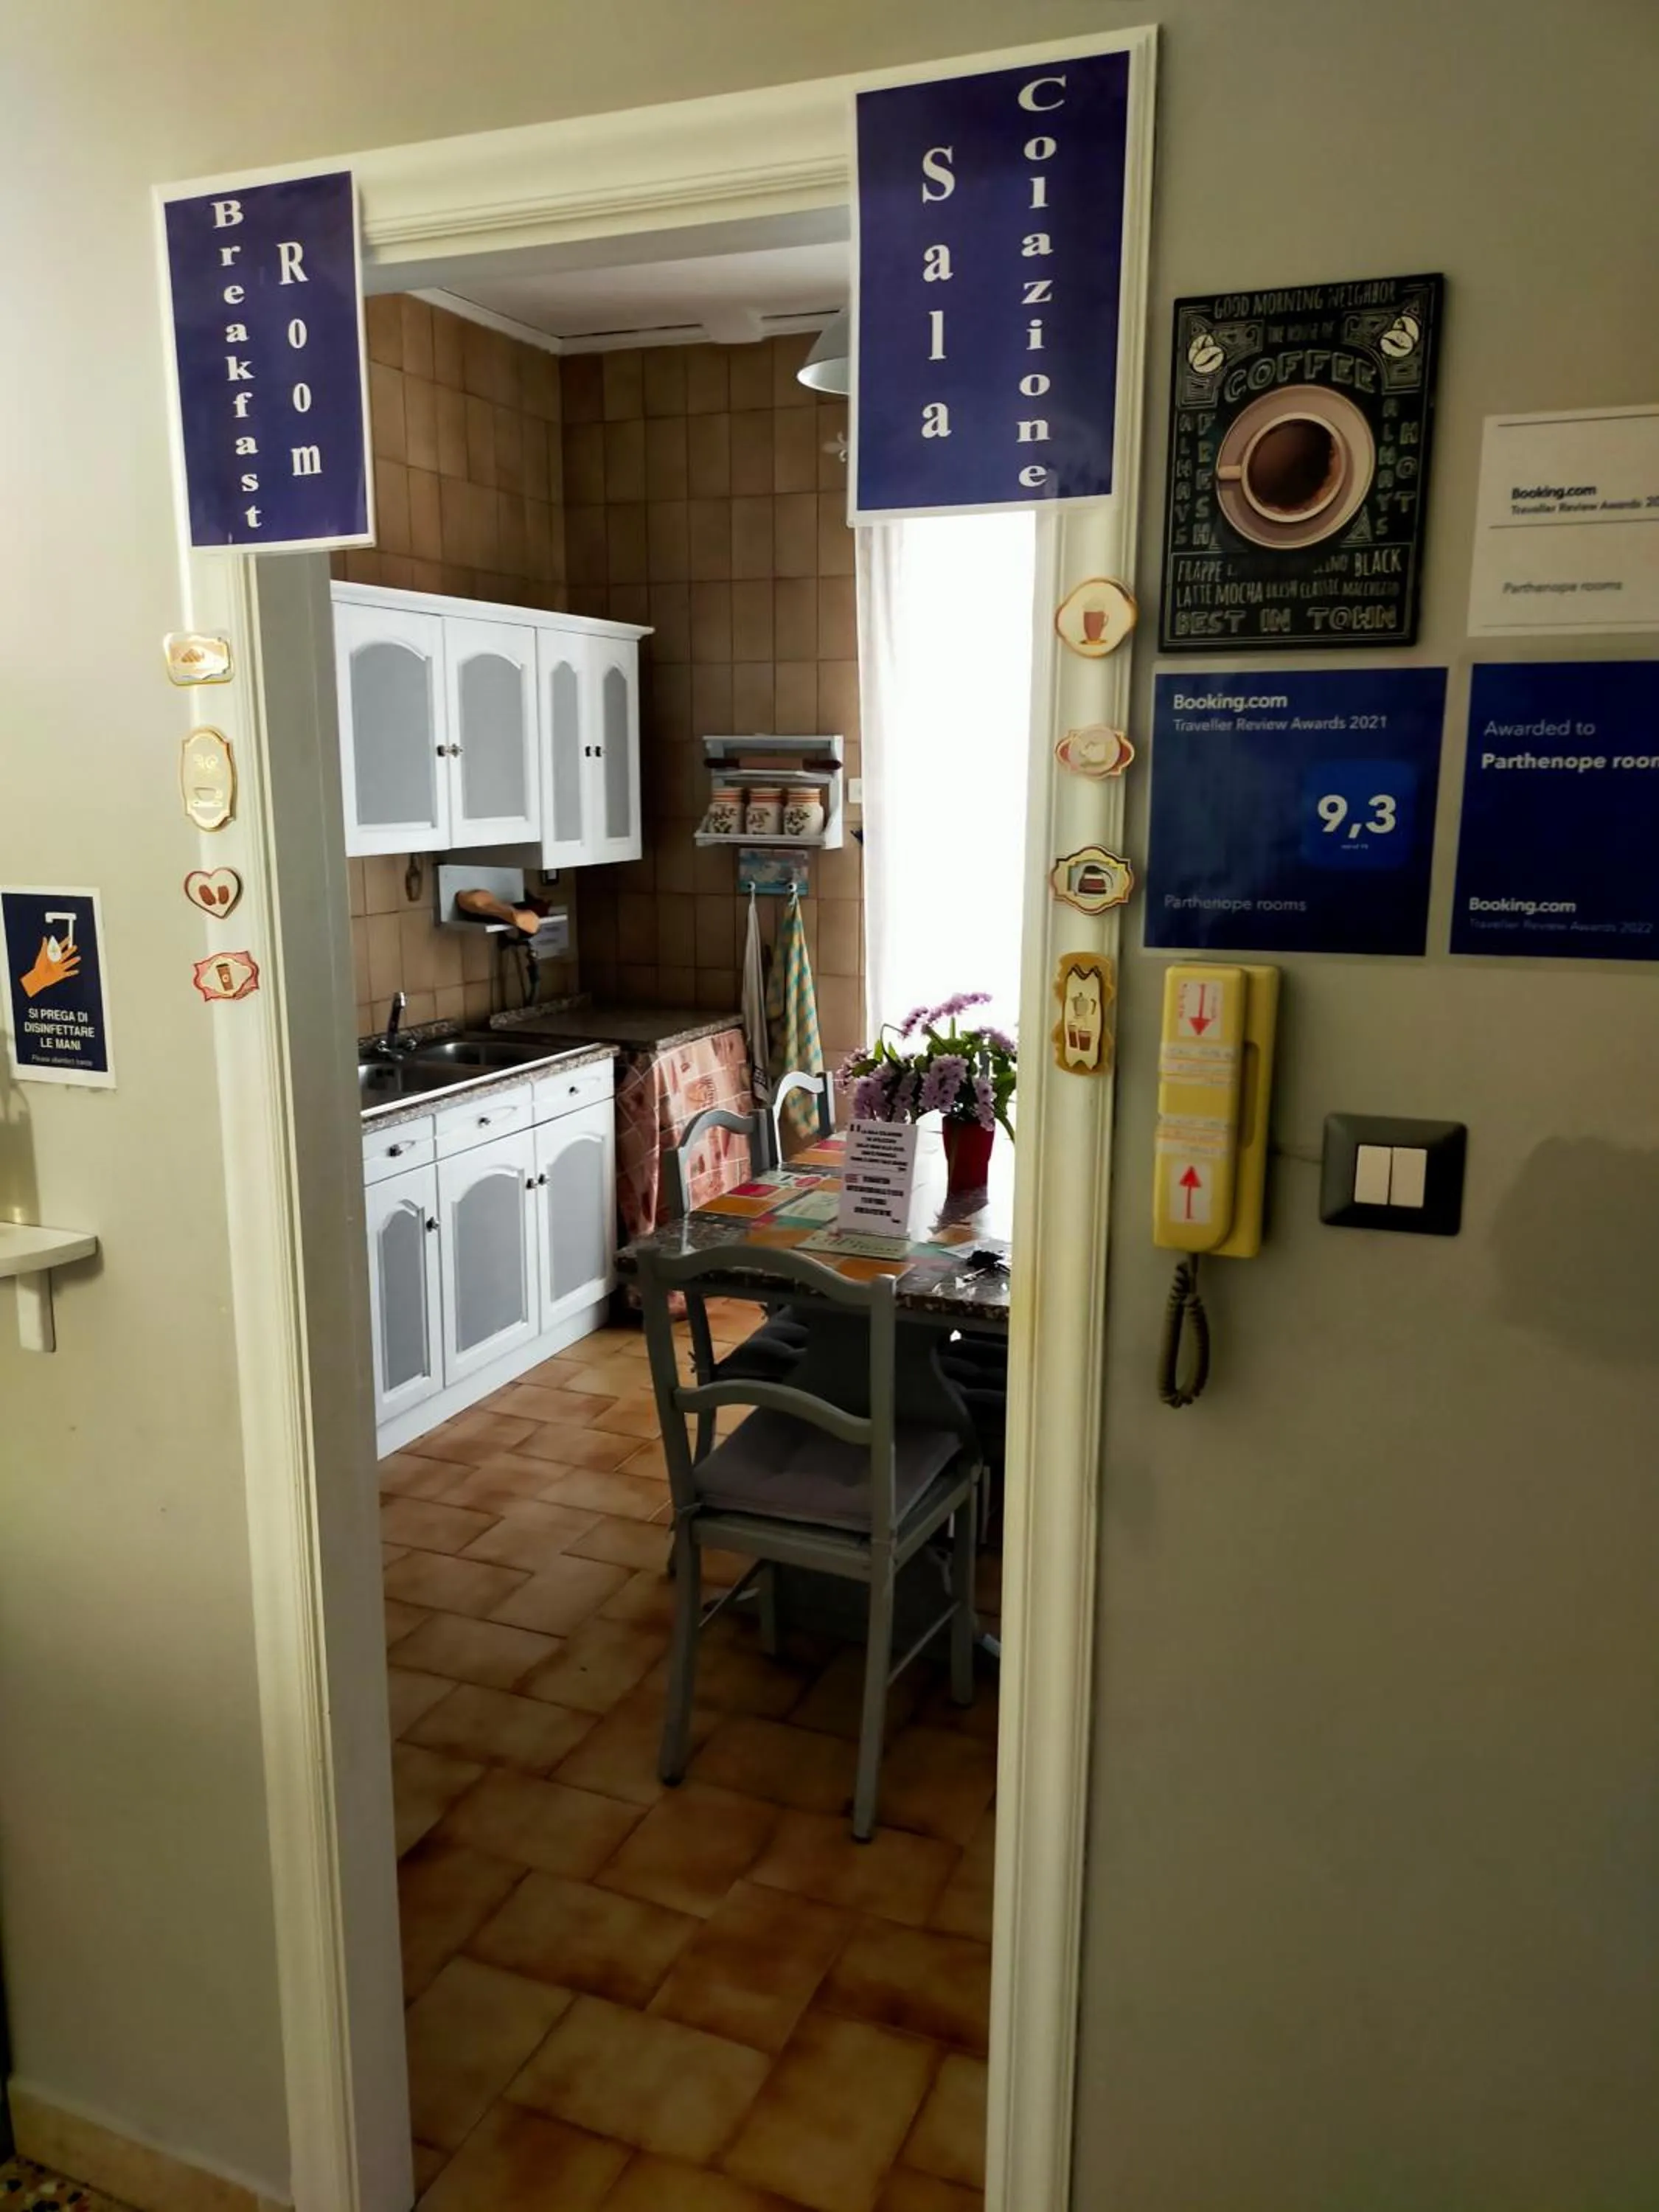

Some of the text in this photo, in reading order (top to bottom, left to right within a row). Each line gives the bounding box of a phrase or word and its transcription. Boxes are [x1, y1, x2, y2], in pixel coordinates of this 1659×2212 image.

[922, 146, 956, 439] Sala
[1017, 75, 1068, 488] Colazione
[1214, 295, 1251, 320] GOOD
[1252, 287, 1324, 317] MORNING
[211, 199, 262, 529] Breakfast
[276, 241, 322, 476] Room
[1222, 349, 1377, 403] COFFEE
[1512, 486, 1597, 500] Booking.com
[1178, 559, 1224, 582] FRAPPE
[1354, 548, 1402, 578] BLACK
[1175, 583, 1213, 608] LATTE
[1214, 580, 1265, 605] MOCHA
[1174, 604, 1399, 636] BEST IN TOWN
[1173, 693, 1288, 712] Booking.com
[1174, 714, 1388, 732] Traveller Review Awards 2021
[1484, 719, 1596, 737] Awarded to
[1481, 752, 1607, 773] Parthenope
[1317, 793, 1397, 838] 9,3
[1164, 894, 1307, 914] Parthenope rooms
[1468, 897, 1577, 915] Booking.com
[29, 1008, 88, 1023] SI PREGA DI
[24, 1021, 95, 1037] DISINFETTARE
[41, 1037, 81, 1050] LE MANI
